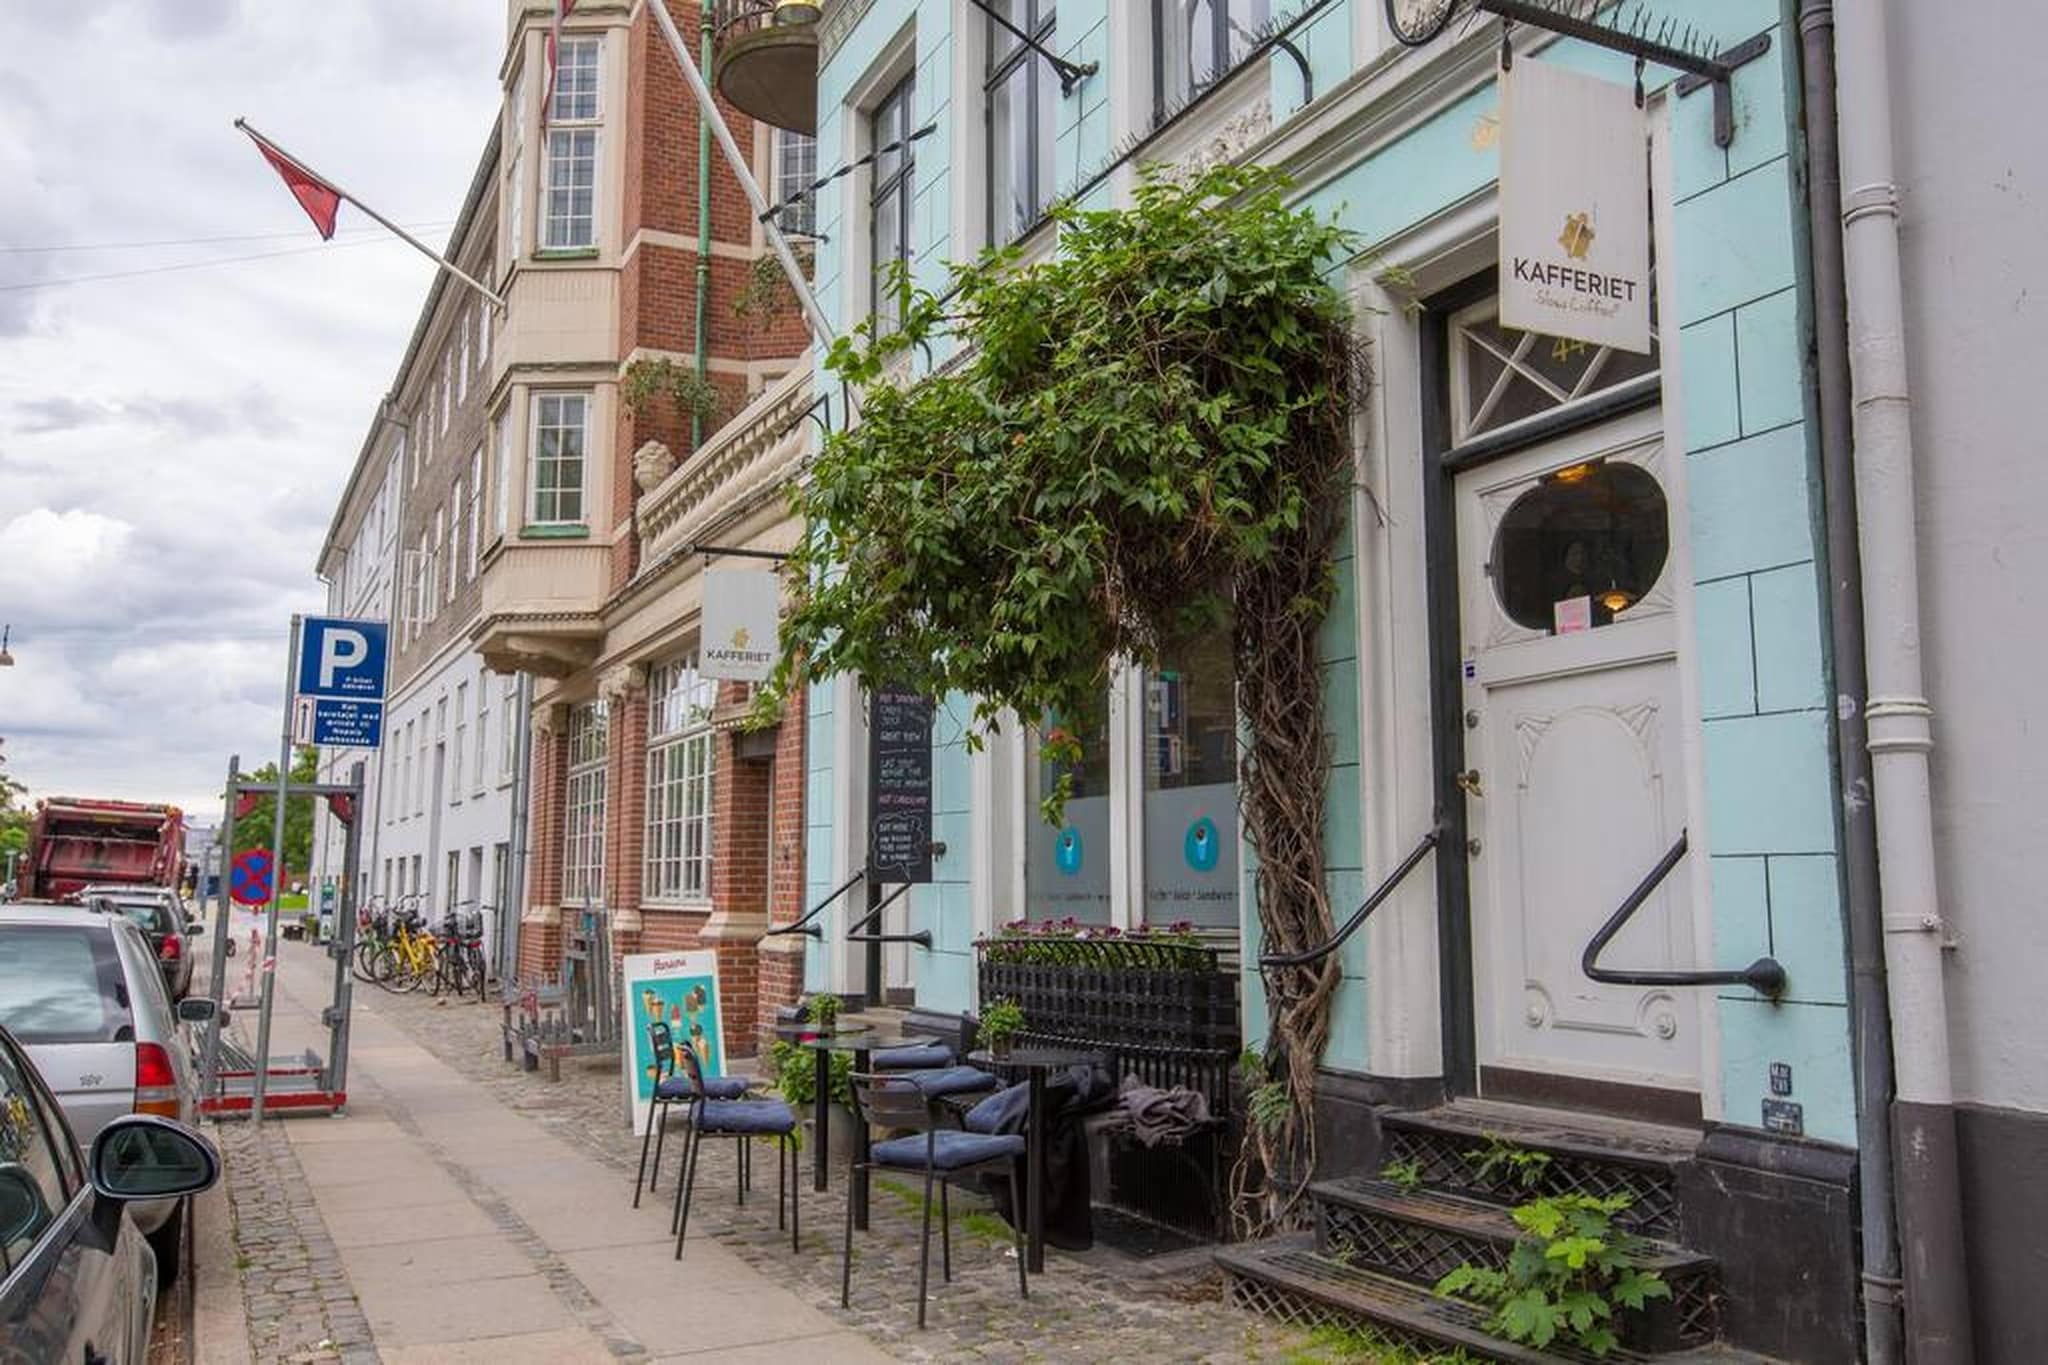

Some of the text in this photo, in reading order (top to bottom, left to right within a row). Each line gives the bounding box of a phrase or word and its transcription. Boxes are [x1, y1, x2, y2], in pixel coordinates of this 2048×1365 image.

[1513, 257, 1637, 302] KAFFERIET
[319, 627, 369, 688] P
[706, 648, 772, 663] KAFFERIET
